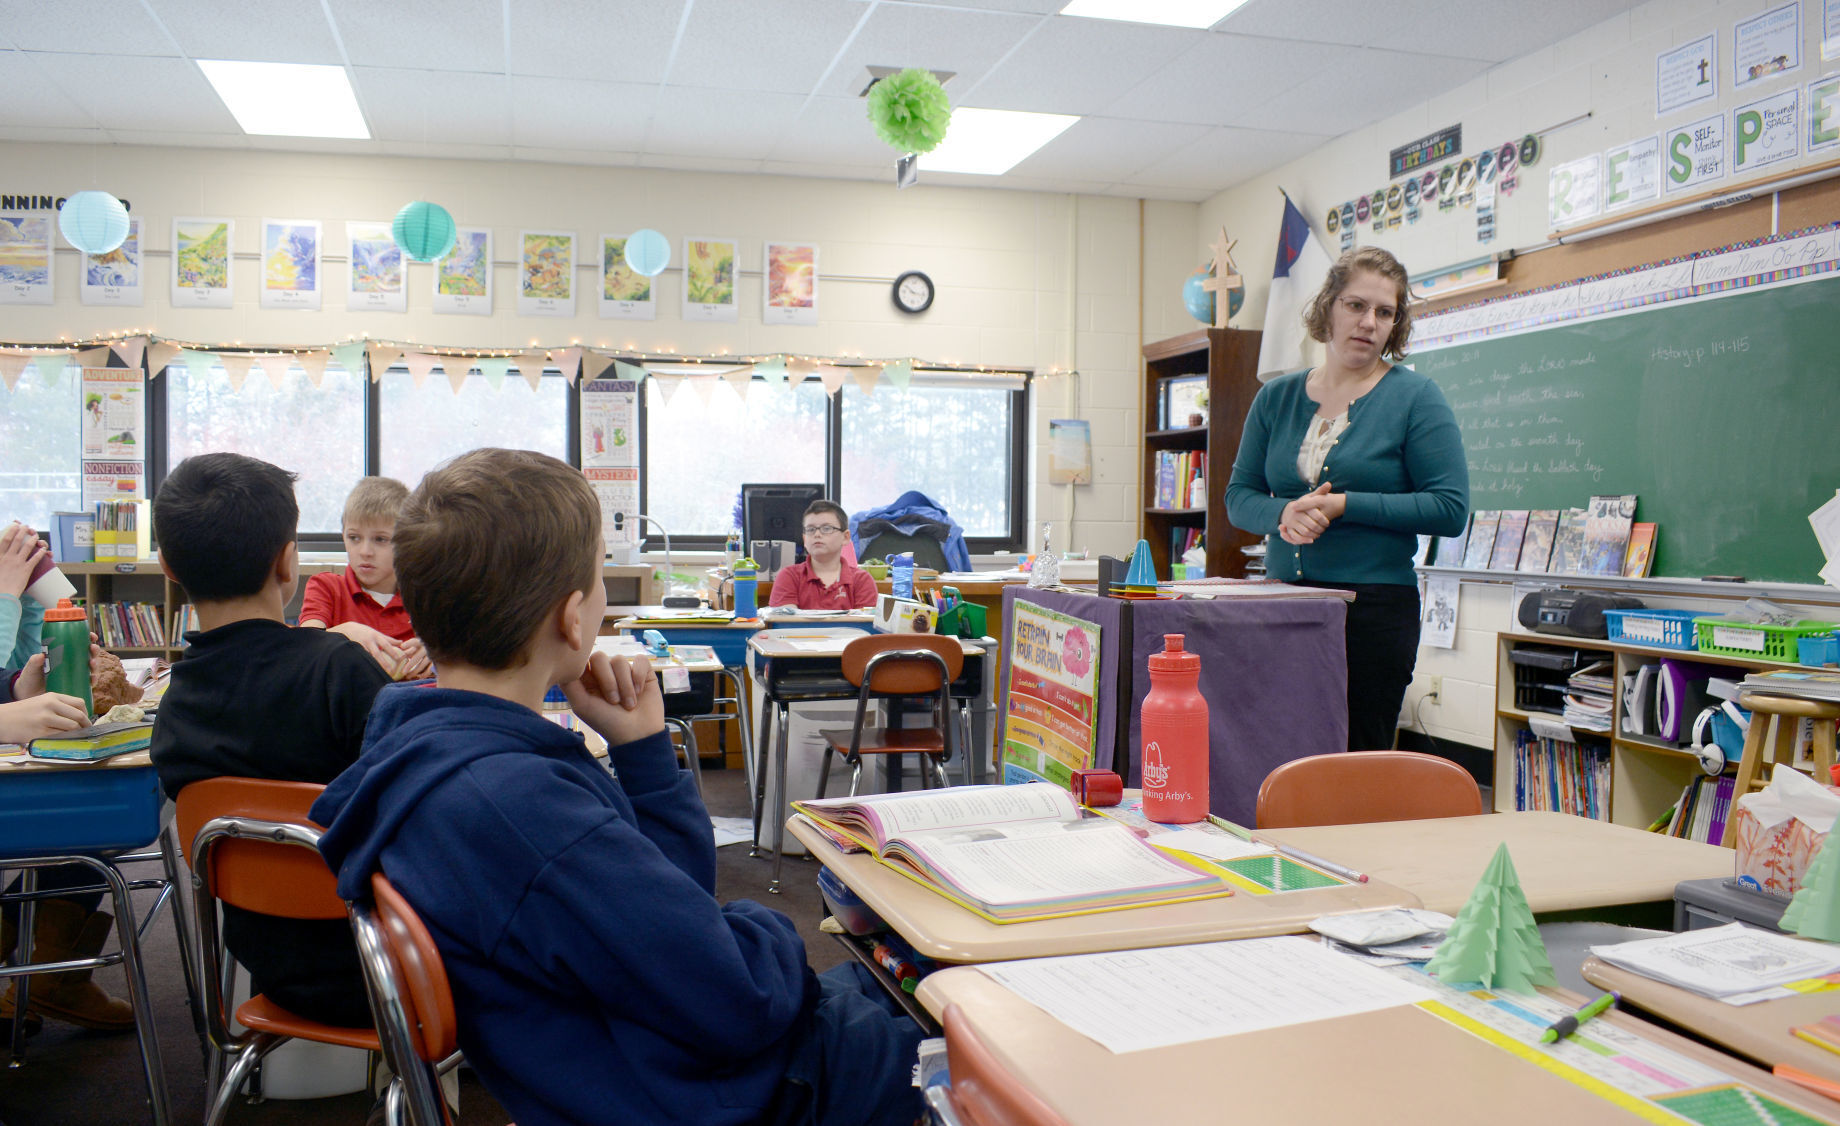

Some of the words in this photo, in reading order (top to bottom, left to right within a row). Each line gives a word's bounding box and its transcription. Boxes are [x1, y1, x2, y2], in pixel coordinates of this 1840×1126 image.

[1764, 101, 1796, 120] Personal
[1765, 113, 1793, 130] SPACE
[1609, 150, 1629, 204] E
[1669, 132, 1692, 183] S
[1736, 110, 1762, 166] P
[1812, 81, 1840, 146] E
[1694, 126, 1716, 142] SELF-
[1396, 137, 1453, 173] BIRTHDAYS
[1694, 138, 1722, 154] Monitor
[1772, 246, 1797, 266] Oo
[1799, 239, 1831, 264] Pp
[1711, 335, 1751, 357] 114-115
[583, 381, 636, 392] ANTASY
[85, 463, 143, 474] NONFICTION
[584, 469, 637, 480] MYSTERY
[1584, 458, 1606, 482] day
[86, 475, 115, 488] essay
[1017, 619, 1051, 647] RETRAIN
[1016, 640, 1034, 662] YOUR
[1035, 647, 1062, 673] BRAIN
[1144, 761, 1168, 782] Arby's
[1165, 791, 1193, 803] Arby's.
[1739, 878, 1757, 889] Great
